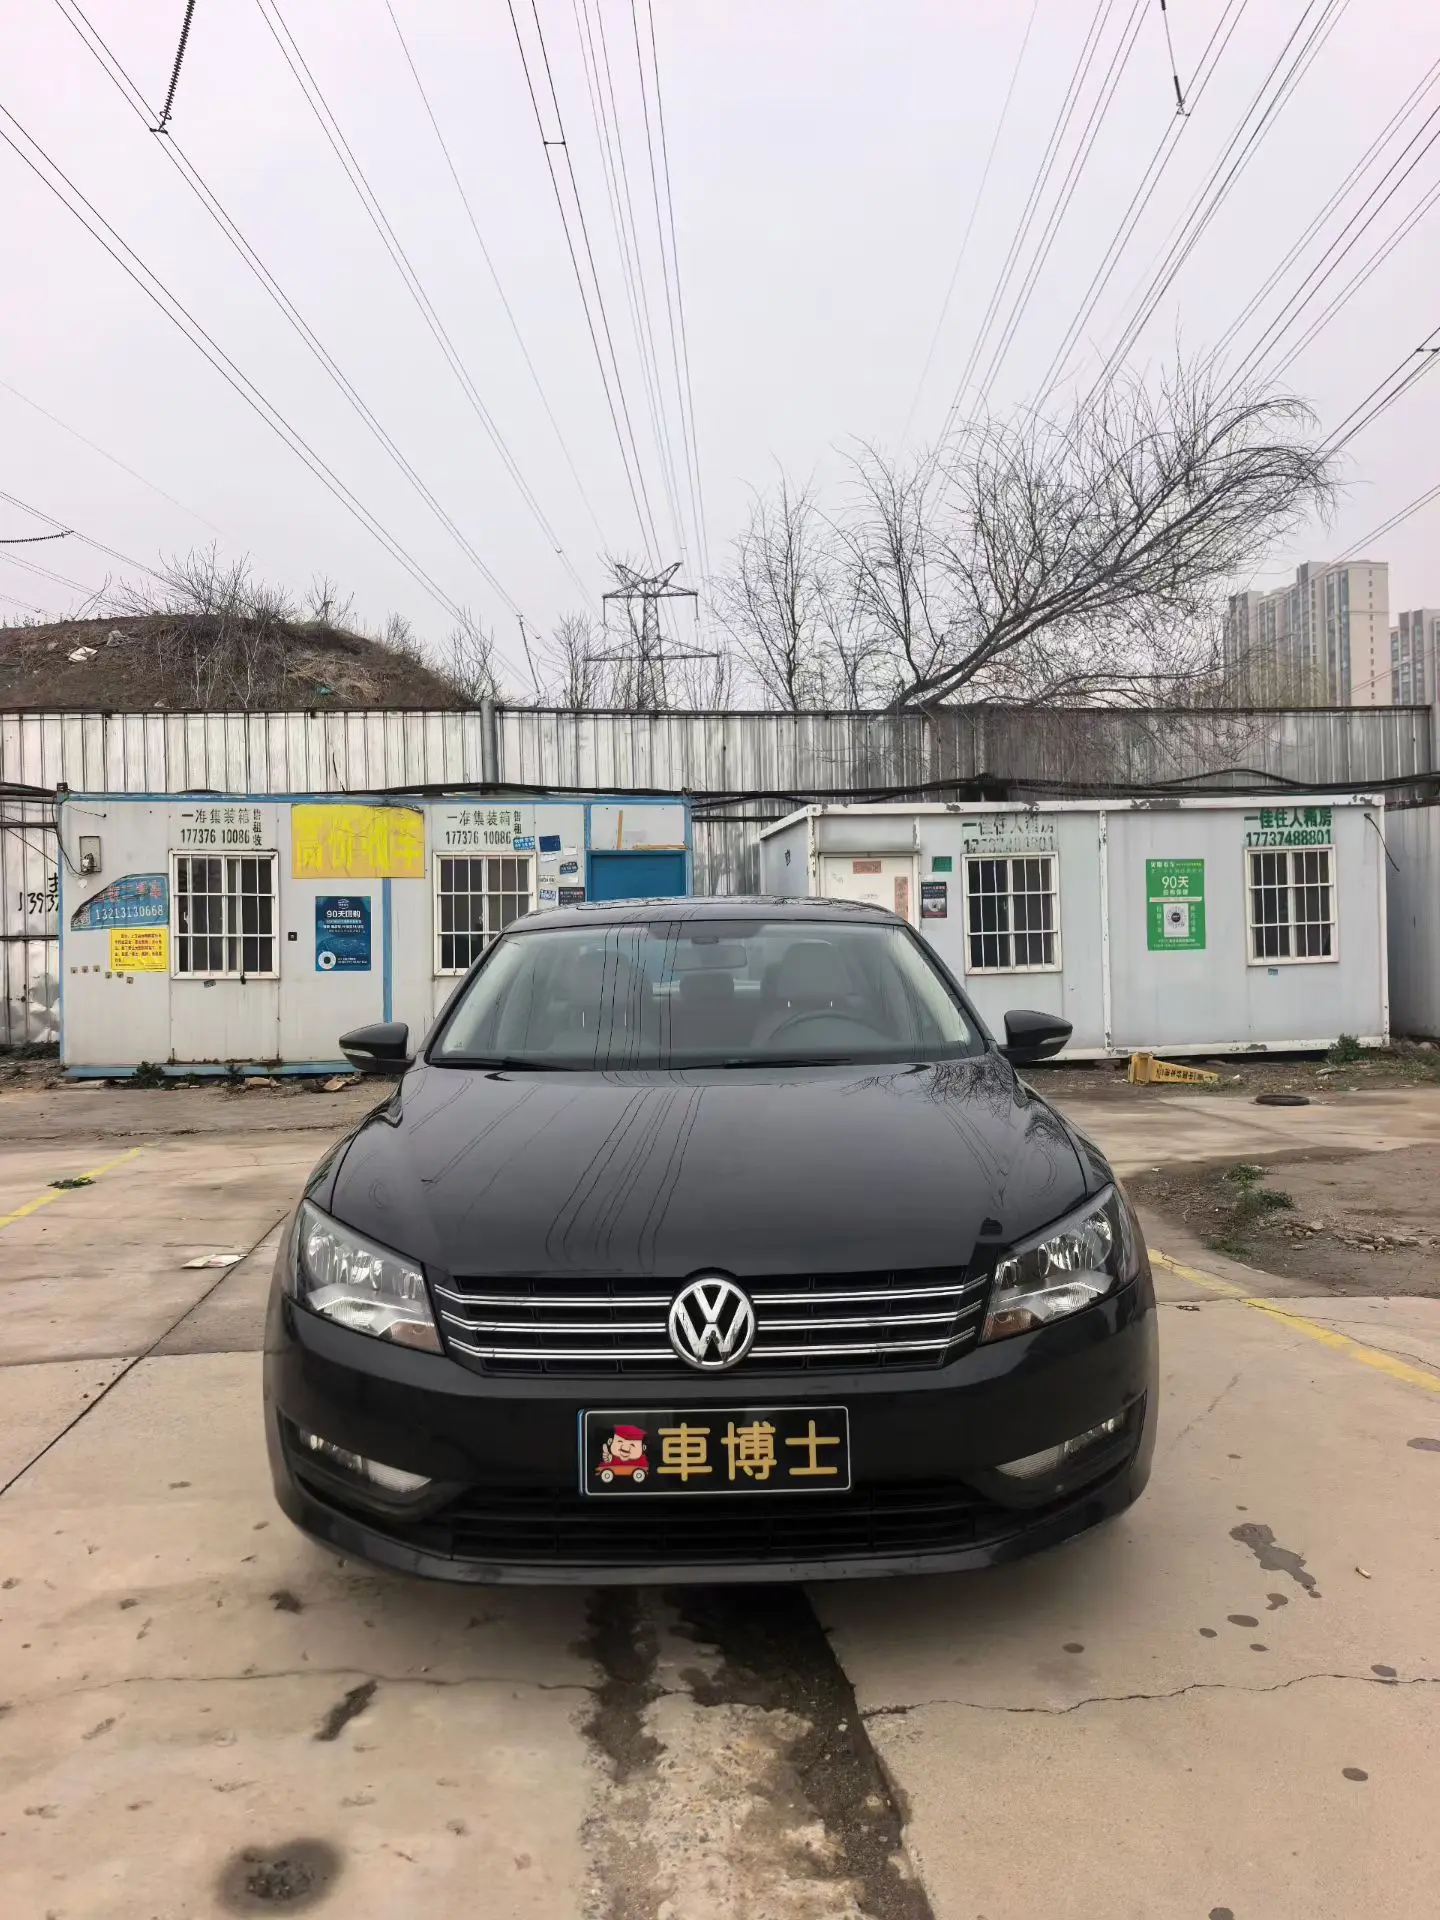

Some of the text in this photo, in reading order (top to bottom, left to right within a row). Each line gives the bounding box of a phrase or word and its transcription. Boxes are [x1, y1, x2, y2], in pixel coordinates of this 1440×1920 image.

[181, 808, 249, 824] 一准集装箱
[181, 828, 250, 844] 177376 10086
[446, 830, 479, 845] 177376
[1246, 829, 1331, 847] 17737488801
[1161, 875, 1189, 889] 90天
[95, 904, 164, 921] 13213130668
[656, 1420, 841, 1482] 車博士
